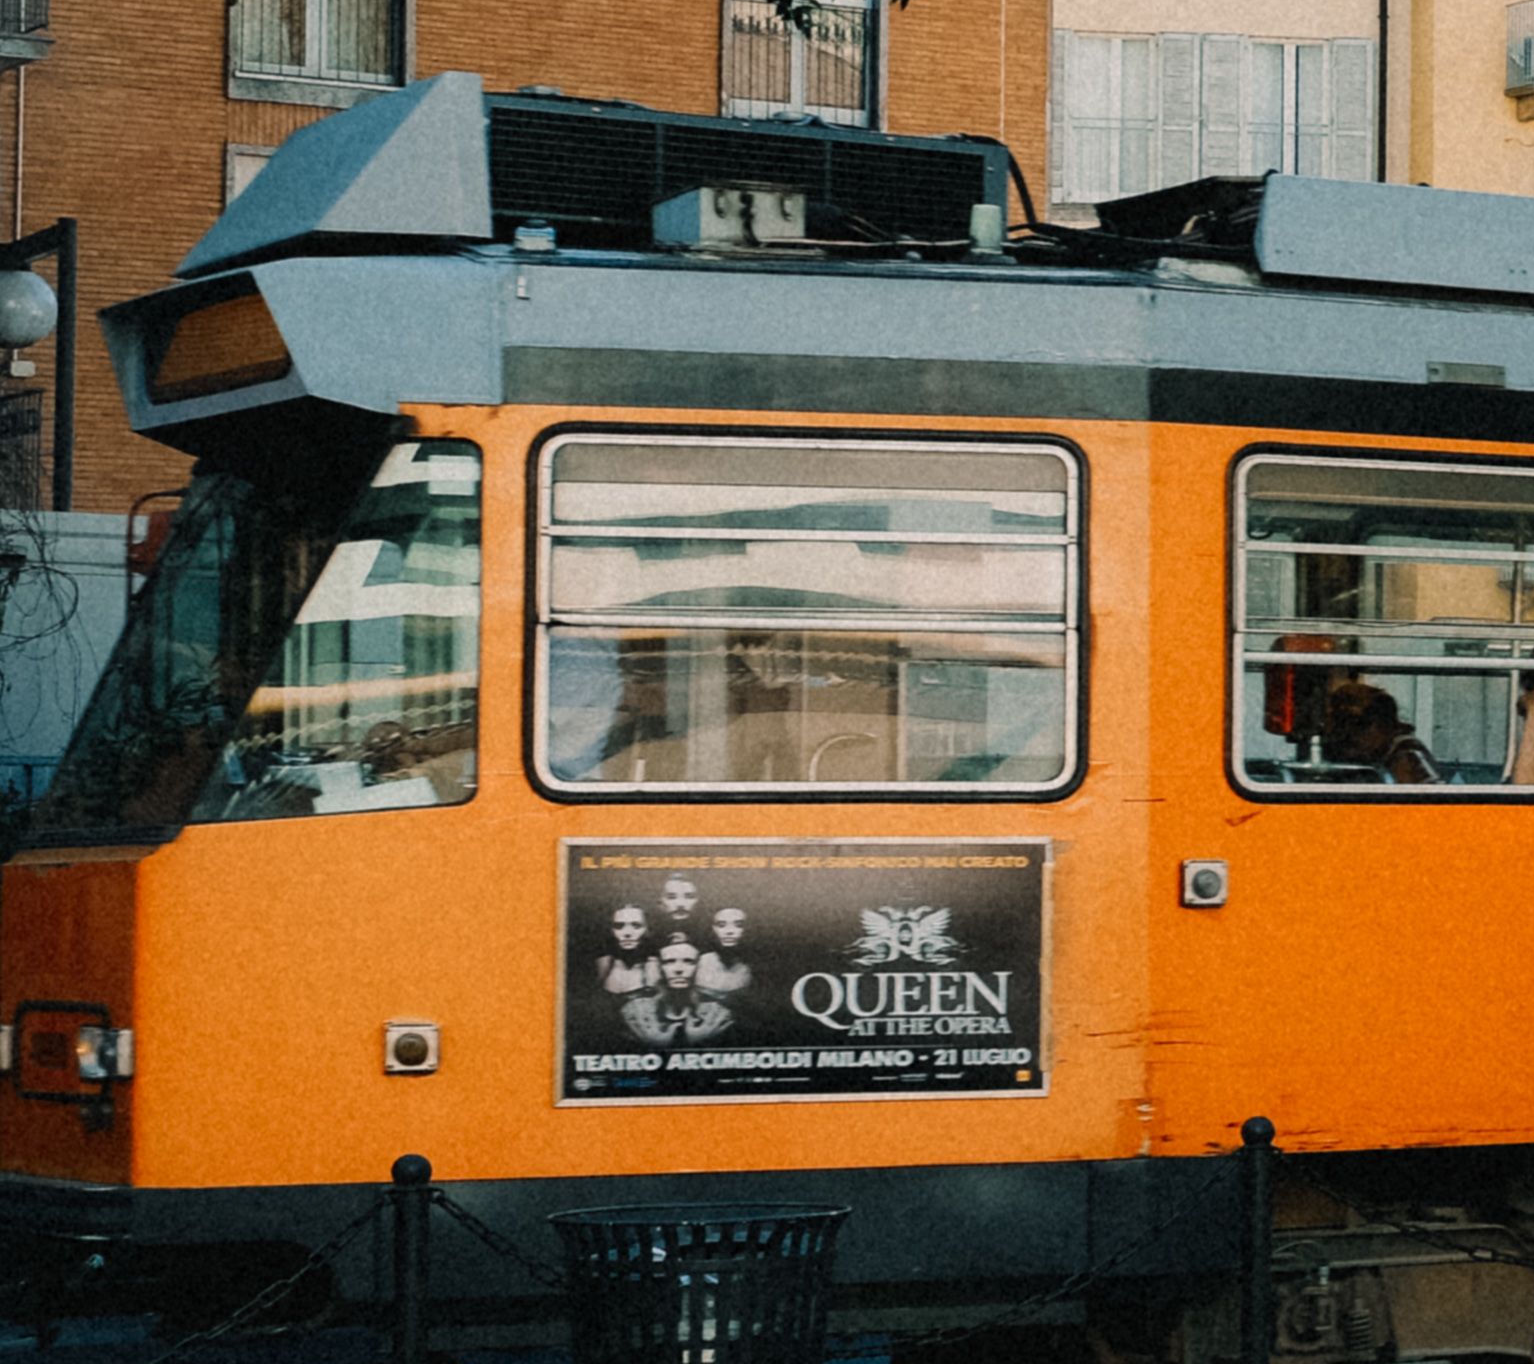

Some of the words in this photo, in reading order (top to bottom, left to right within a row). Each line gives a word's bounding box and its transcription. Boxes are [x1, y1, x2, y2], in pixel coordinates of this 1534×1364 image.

[580, 856, 599, 870] IL
[634, 855, 711, 869] GRANDE
[713, 855, 768, 869] SHOW
[959, 855, 1030, 869] CREATO
[791, 971, 1013, 1030] QUEEN
[848, 1017, 882, 1037] AT
[880, 1016, 934, 1036] THE
[934, 1016, 1013, 1036] OPERA
[573, 1054, 663, 1072] TEATRO
[665, 1051, 812, 1070] ARCIMBOLDI
[817, 1049, 914, 1068] MILANO
[933, 1049, 957, 1066] 21
[962, 1047, 1032, 1066] LUGLIO
